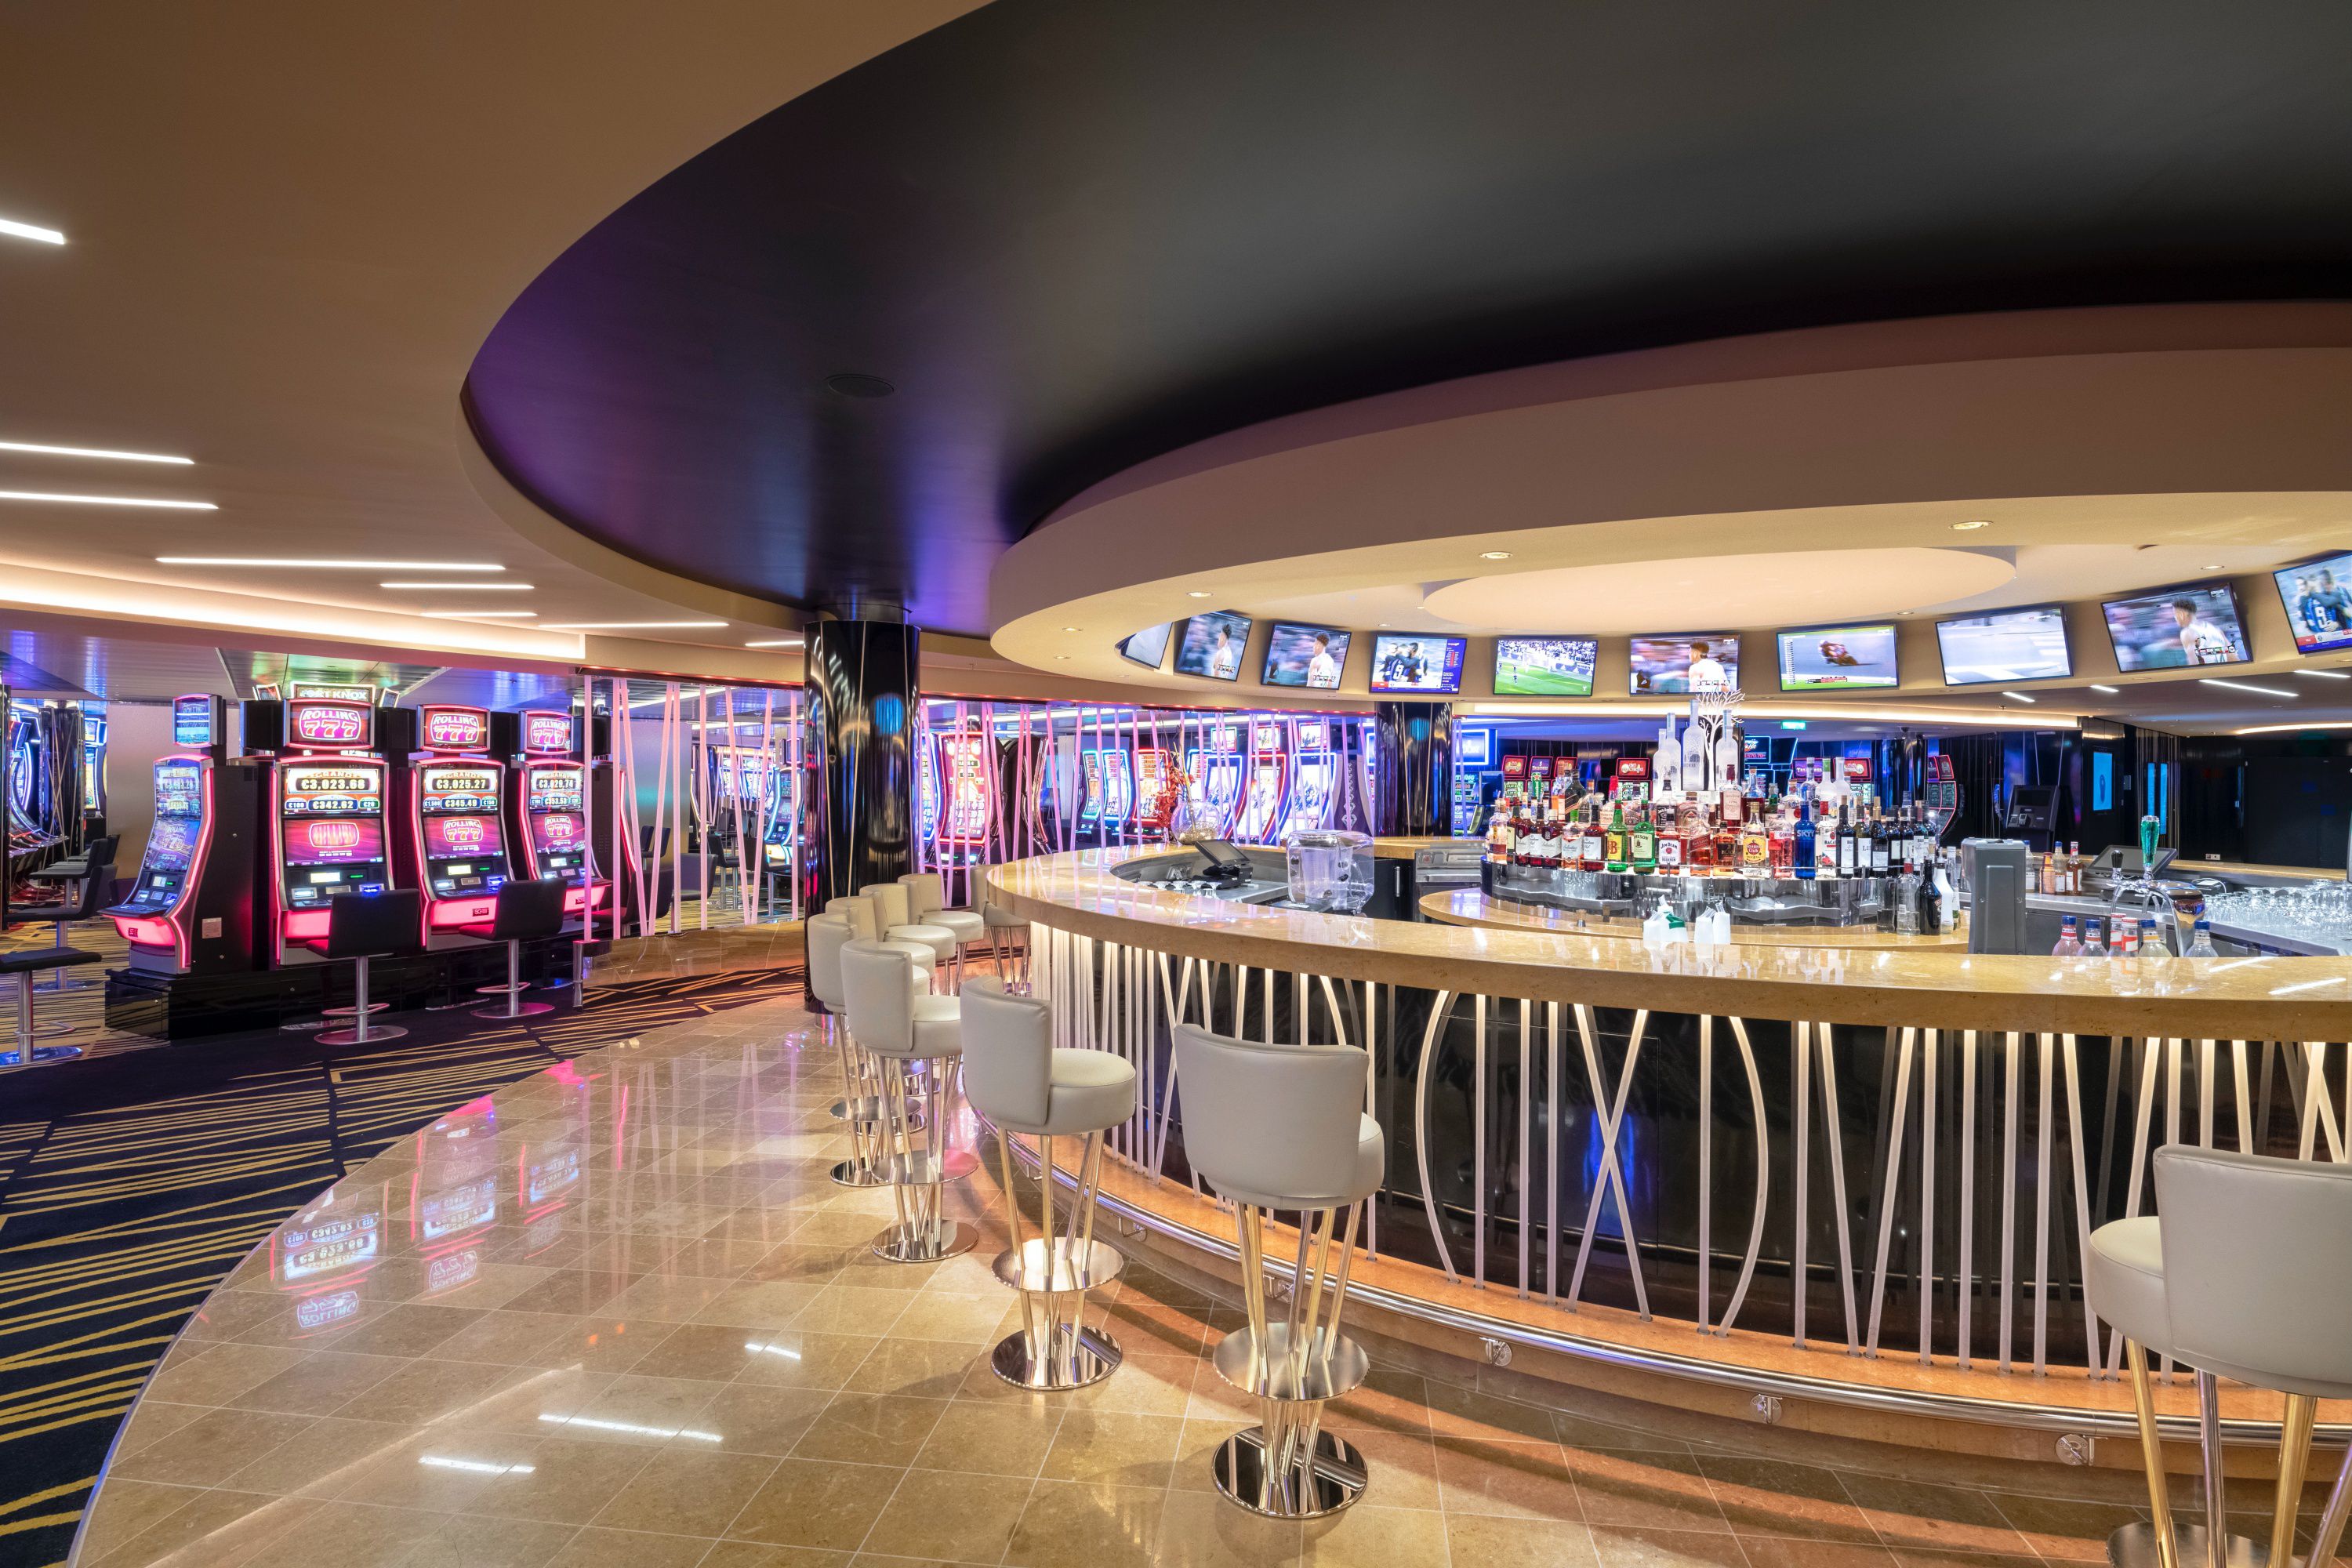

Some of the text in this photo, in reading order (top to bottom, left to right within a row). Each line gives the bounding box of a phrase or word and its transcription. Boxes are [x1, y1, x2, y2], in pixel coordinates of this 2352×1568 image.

[303, 710, 359, 721] ROLLING
[433, 716, 477, 726] ROLLING
[304, 720, 358, 738] 777
[434, 724, 477, 741] 777
[445, 820, 481, 829] ROLLING
[447, 827, 481, 841] 777
